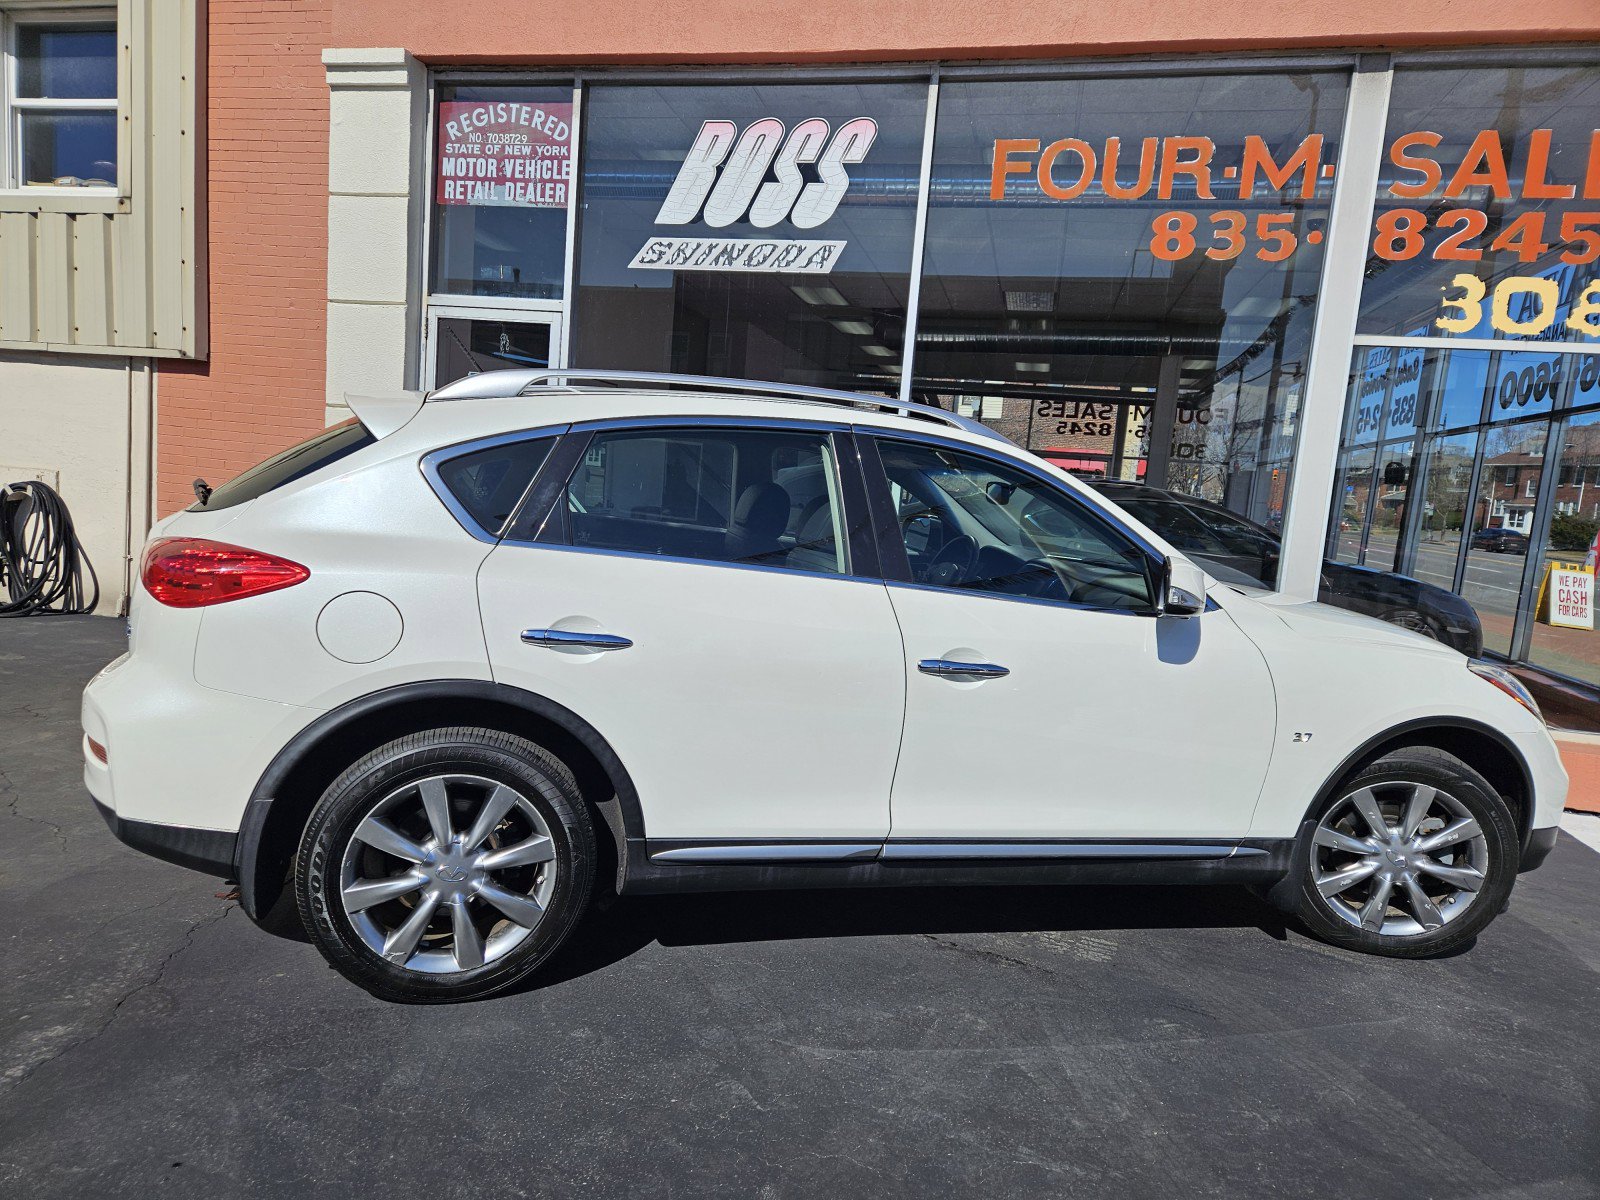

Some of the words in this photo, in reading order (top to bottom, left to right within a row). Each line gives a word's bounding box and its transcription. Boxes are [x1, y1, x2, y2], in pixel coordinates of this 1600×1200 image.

[445, 103, 569, 141] REGISTERED
[487, 133, 528, 144] 7038729
[445, 142, 481, 154] STATE
[485, 145, 501, 154] OF
[504, 145, 532, 156] NEW
[536, 146, 568, 156] YORK
[442, 157, 498, 178] MOTOR
[504, 158, 571, 180] VEHICLE
[654, 117, 879, 229] BOSS
[444, 180, 499, 200] RETAIL
[504, 181, 566, 202] DEALER
[1373, 208, 1600, 265] 8245
[1558, 576, 1570, 587] WE
[1573, 577, 1588, 588] PAY
[1558, 588, 1588, 606] CASH
[1558, 605, 1571, 616] FOR
[1572, 606, 1588, 618] CARS
